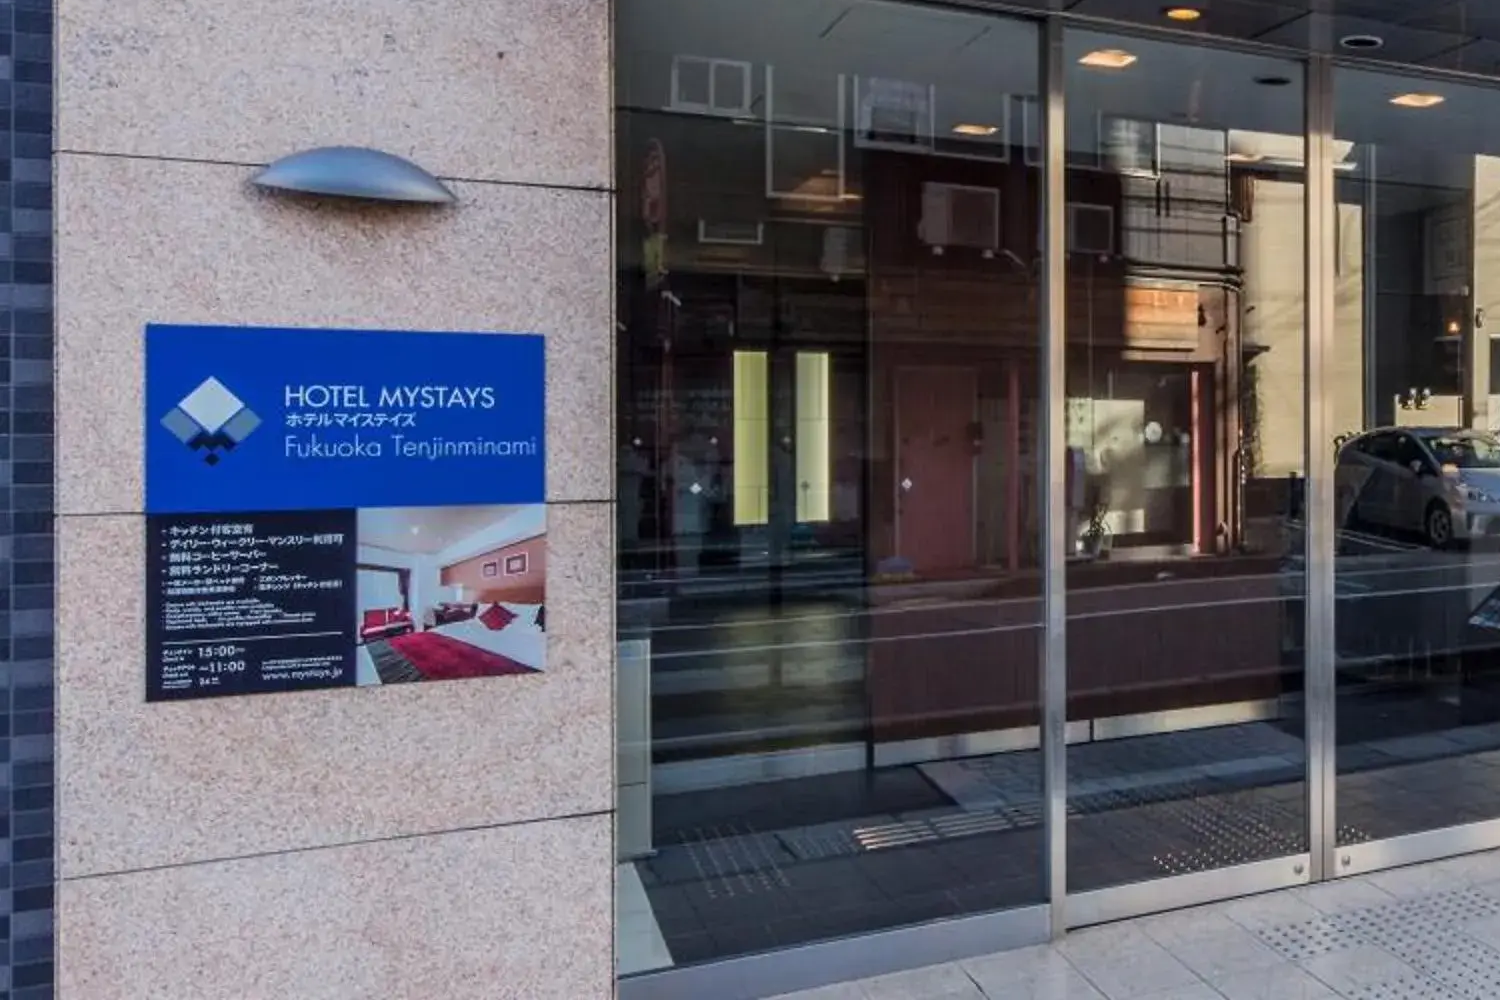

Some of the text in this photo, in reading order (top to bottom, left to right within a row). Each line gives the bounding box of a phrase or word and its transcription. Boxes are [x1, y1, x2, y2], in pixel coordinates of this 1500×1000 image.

[284, 385, 496, 408] HOTEL MYSTAYS
[286, 412, 417, 428] ホテルマイステイズ
[285, 433, 537, 460] Fukuoka Tenjinminami
